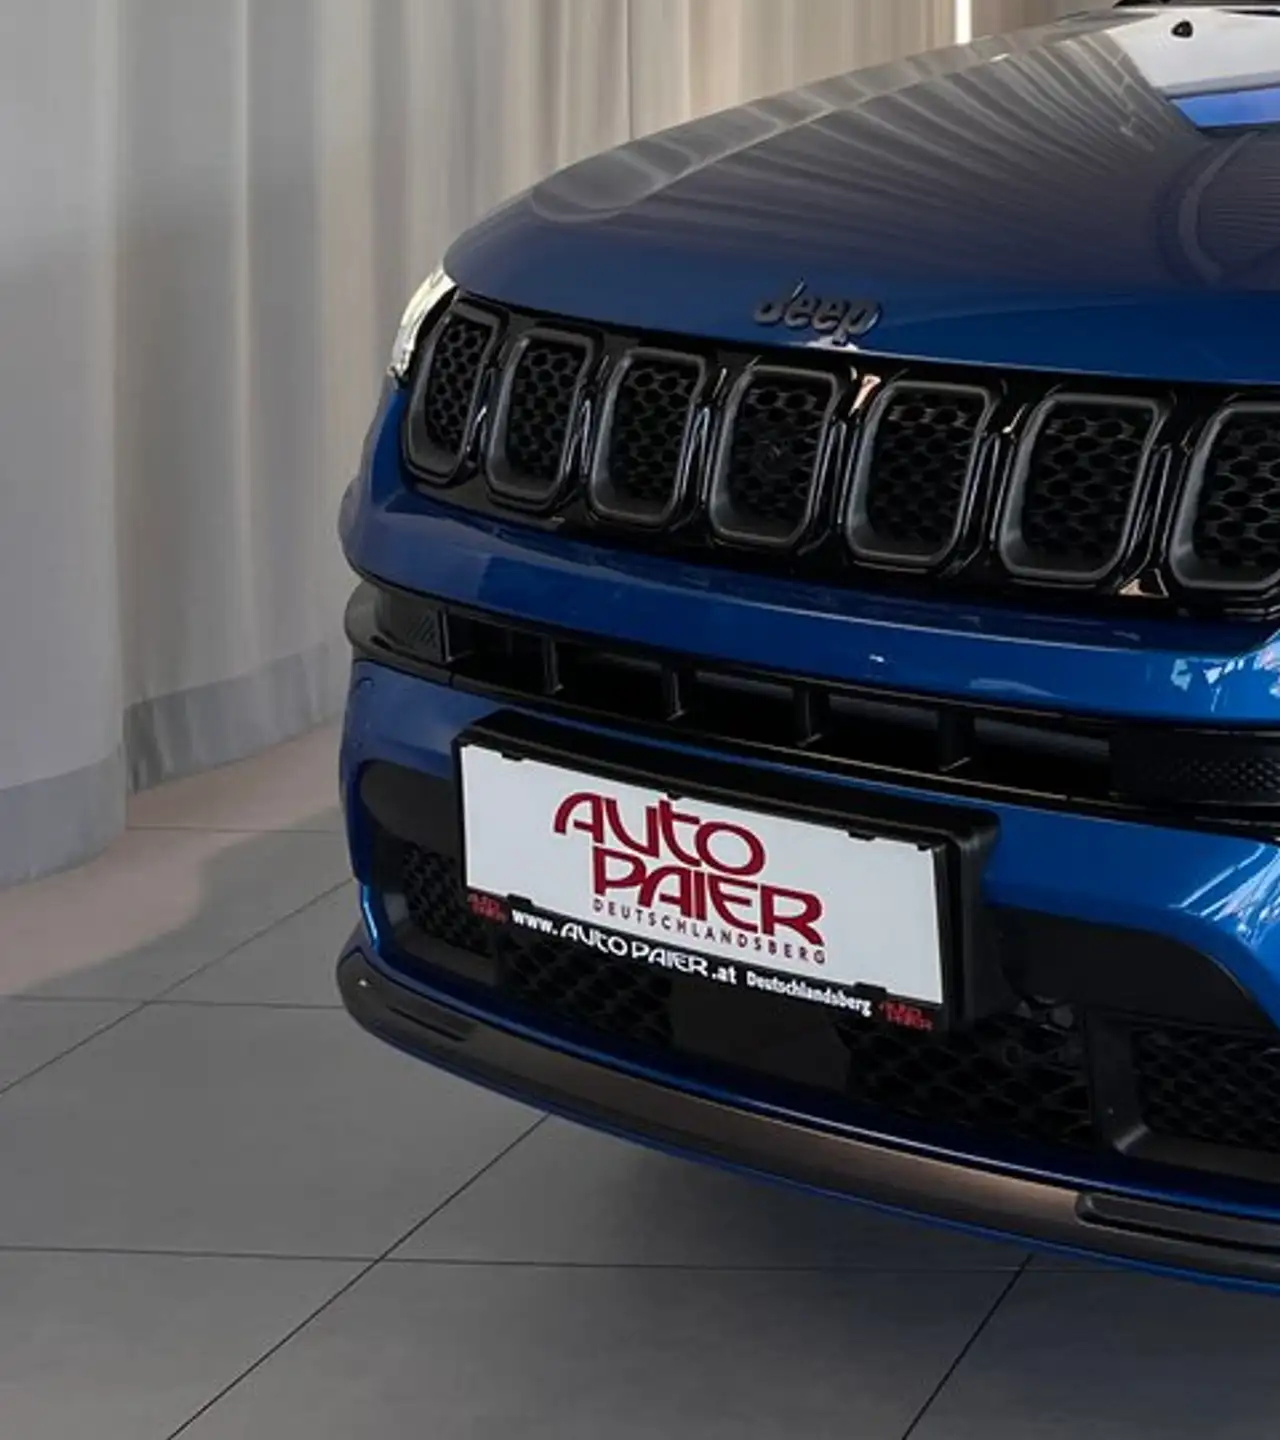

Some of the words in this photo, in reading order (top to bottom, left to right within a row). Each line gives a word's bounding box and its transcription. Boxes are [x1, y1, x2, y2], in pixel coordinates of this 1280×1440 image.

[753, 277, 882, 346] Jeep
[592, 845, 825, 947] PAIER
[592, 897, 826, 965] DEUTSCHLANDSBERG
[746, 970, 873, 1018] Deutschlandsberg
